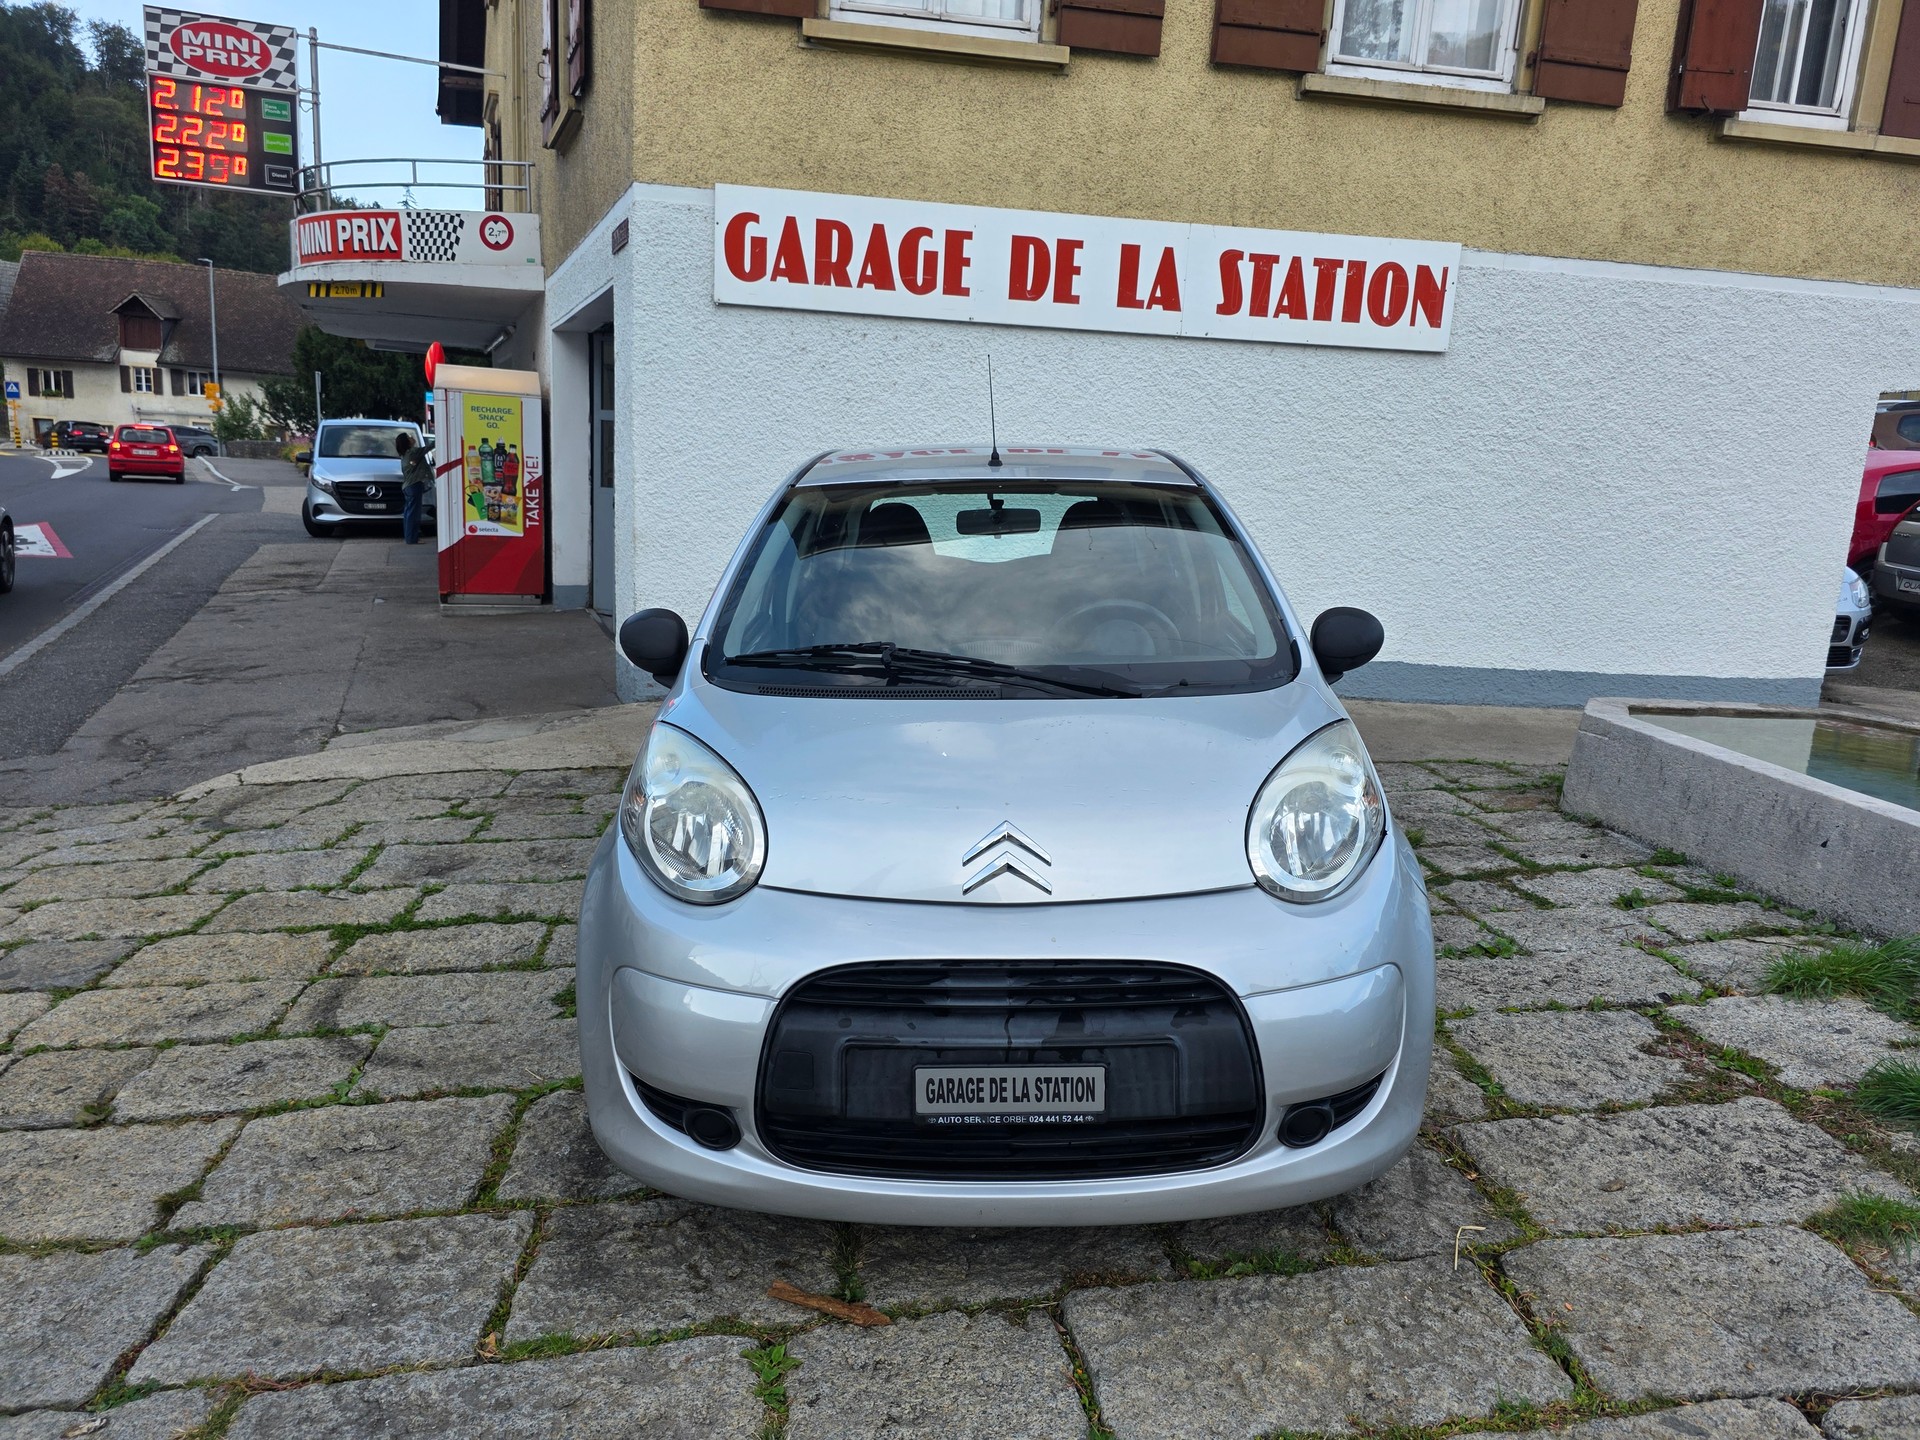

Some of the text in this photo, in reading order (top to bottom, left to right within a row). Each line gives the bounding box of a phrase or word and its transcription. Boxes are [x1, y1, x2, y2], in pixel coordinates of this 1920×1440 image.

[181, 28, 261, 54] MINI
[182, 45, 262, 70] PRIX
[300, 217, 399, 256] MINI PRIX
[724, 213, 1447, 329] GARAGE DE LA STATION
[470, 405, 515, 415] RECHARGE.
[478, 413, 507, 422] SNACK.
[486, 421, 500, 429] GO.
[526, 455, 540, 528] TAKE ME!
[926, 1076, 1096, 1104] GARAGE DE LA STATION
[937, 1116, 962, 1124] AUTO
[1029, 1115, 1044, 1123] 024
[1045, 1115, 1061, 1123] 441
[1062, 1115, 1072, 1123] 52
[1073, 1115, 1084, 1123] 44
